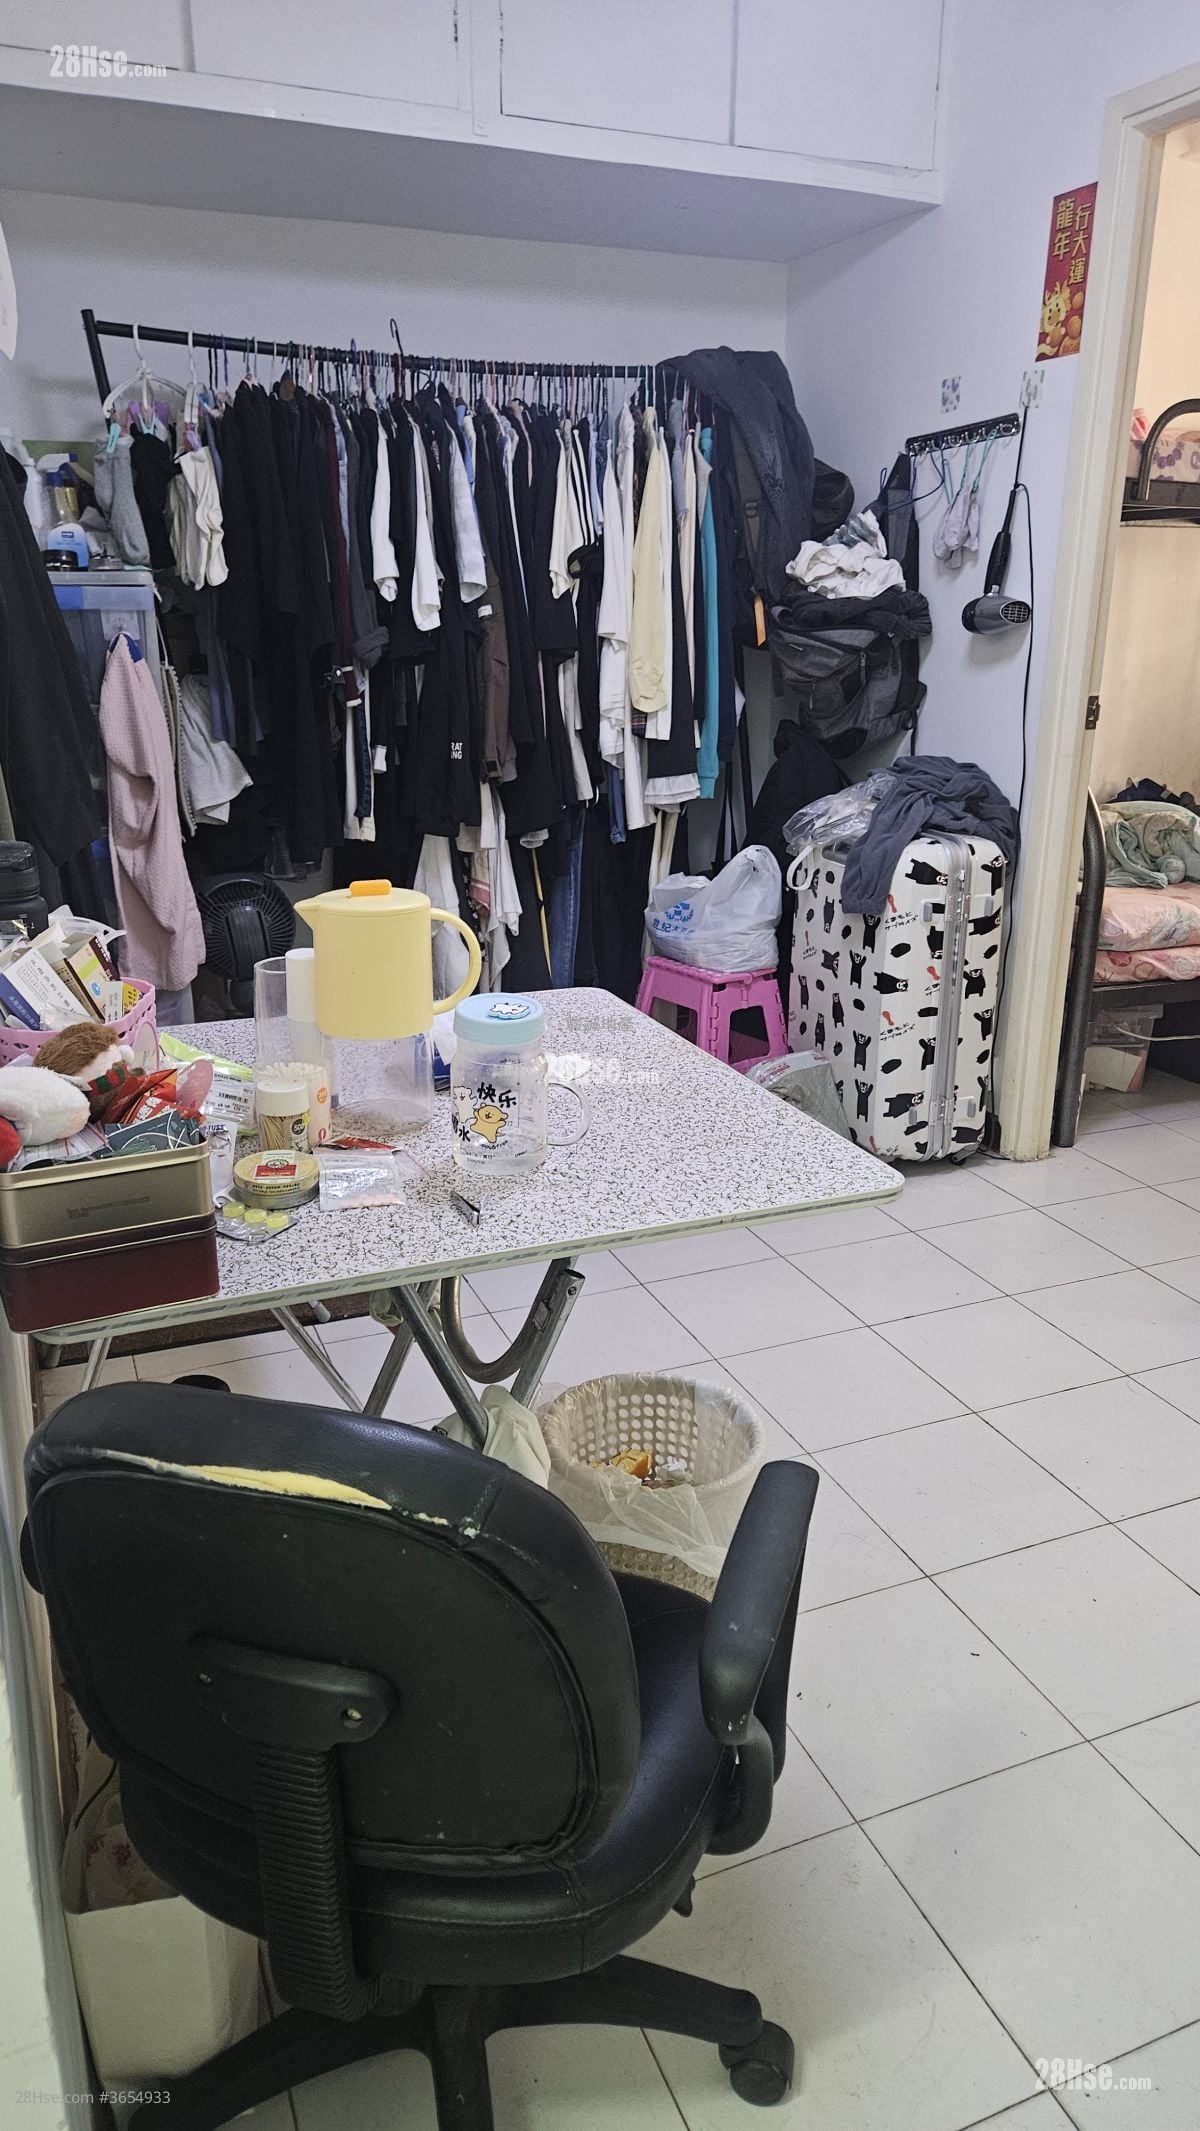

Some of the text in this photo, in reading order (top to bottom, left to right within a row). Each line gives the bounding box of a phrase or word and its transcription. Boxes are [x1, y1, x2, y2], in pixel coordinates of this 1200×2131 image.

[1053, 198, 1075, 261] 龍年
[1068, 203, 1092, 285] 行大運
[477, 1082, 517, 1108] 快乐
